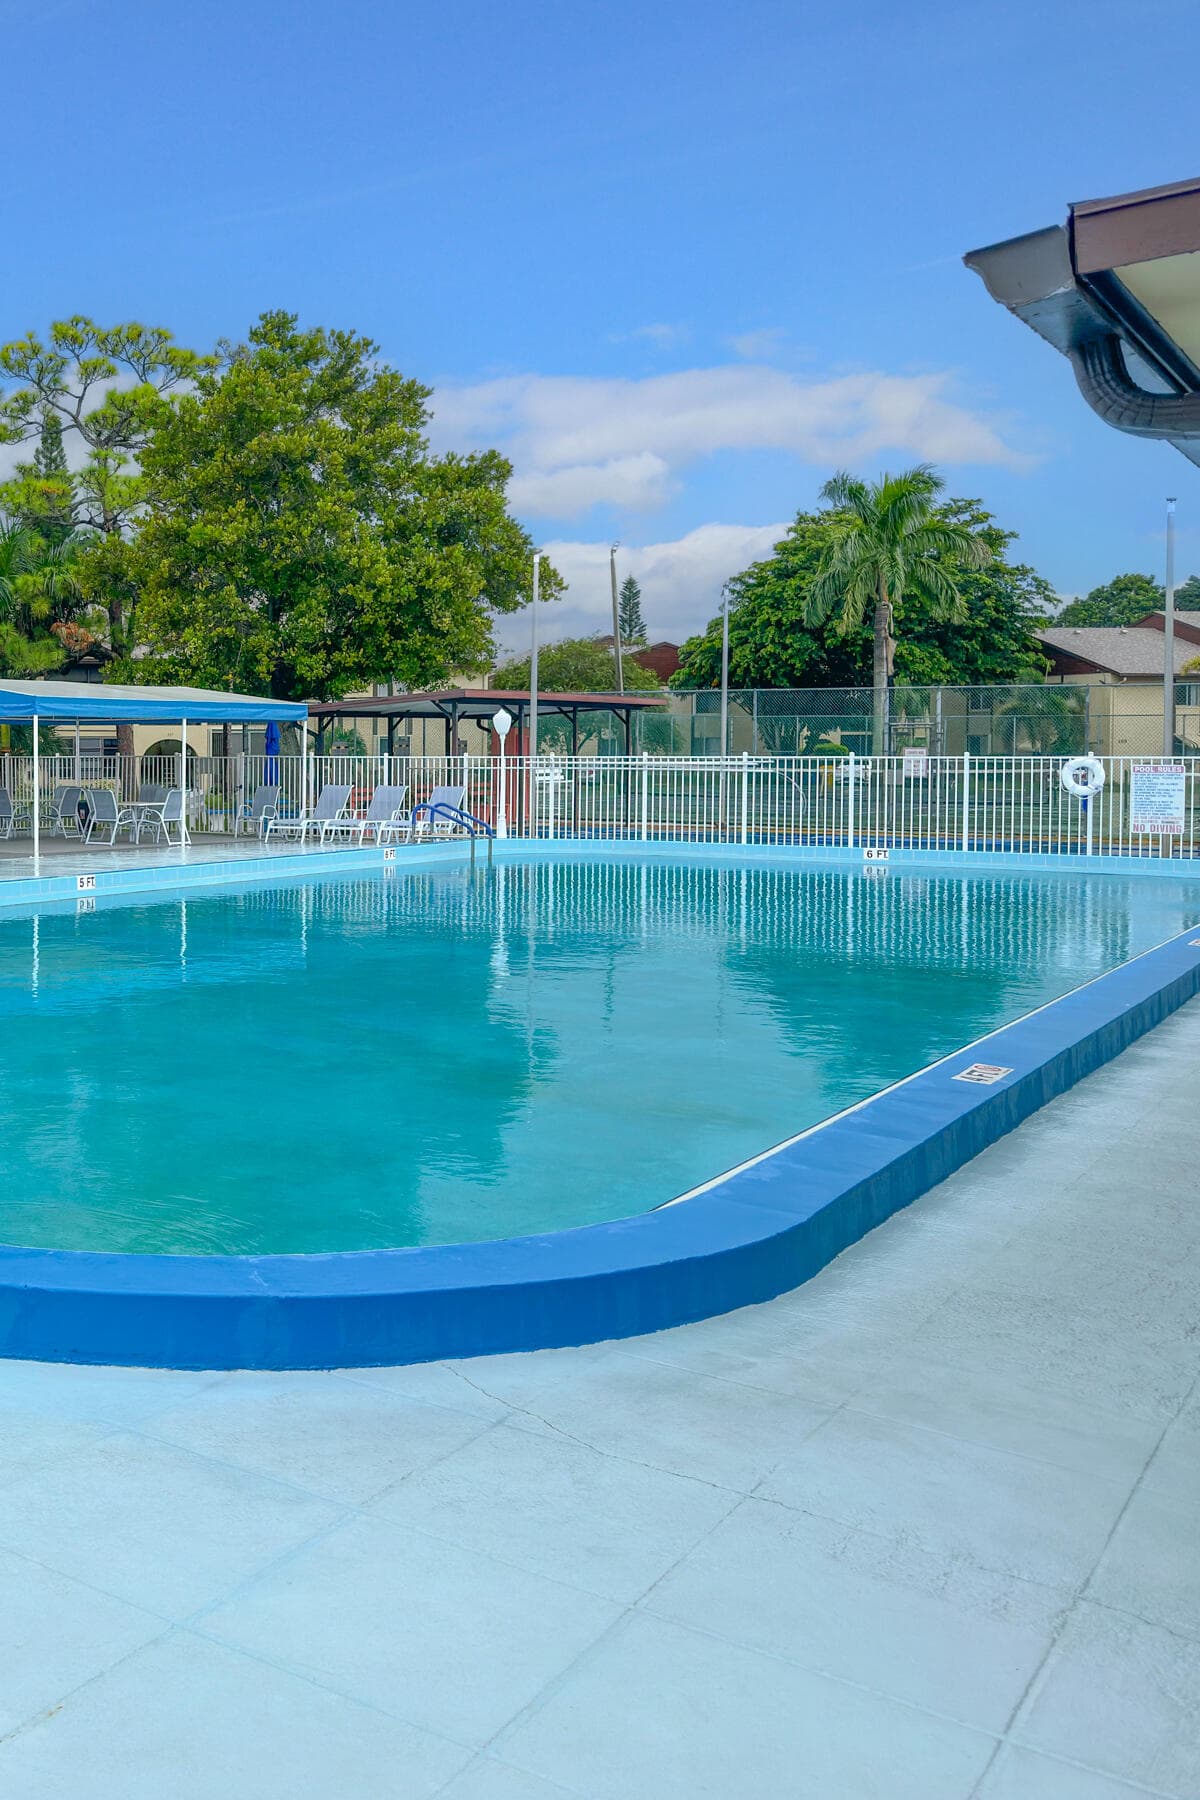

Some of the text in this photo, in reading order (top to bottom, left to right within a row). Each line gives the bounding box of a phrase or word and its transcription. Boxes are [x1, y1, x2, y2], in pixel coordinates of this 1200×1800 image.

[1133, 823, 1183, 833] NO DIVING
[866, 850, 873, 859] 6
[79, 877, 85, 888] 5
